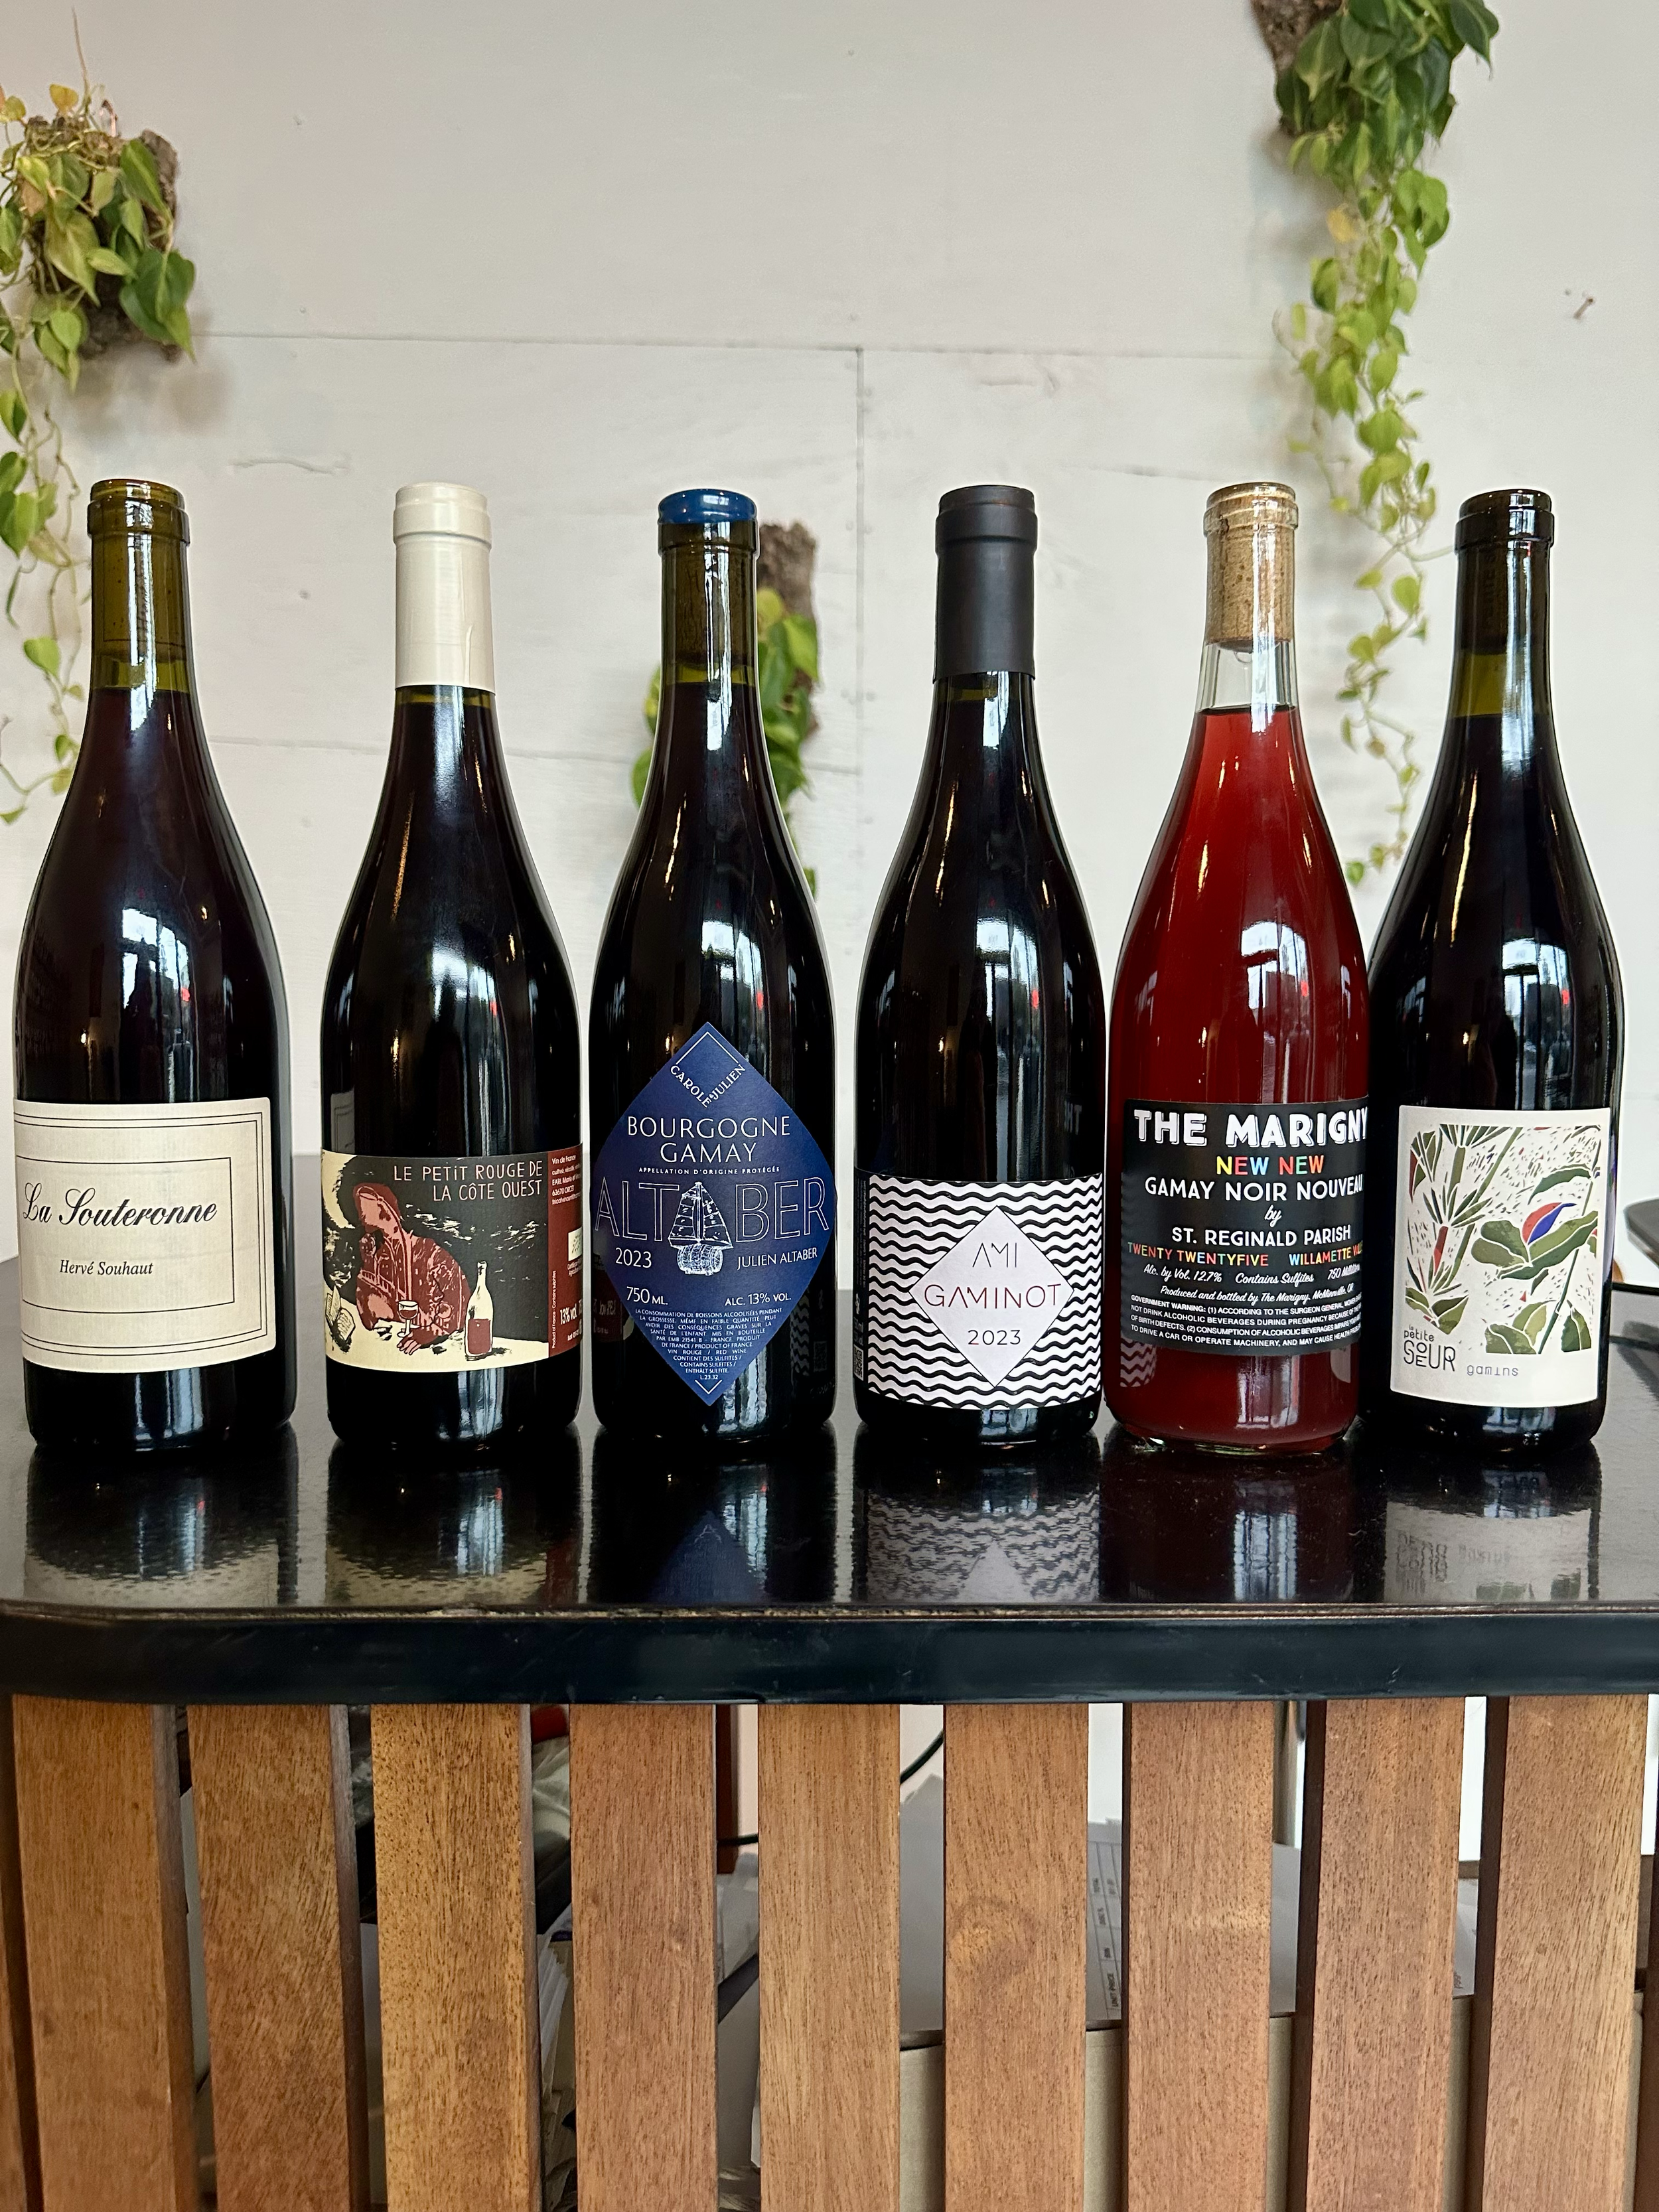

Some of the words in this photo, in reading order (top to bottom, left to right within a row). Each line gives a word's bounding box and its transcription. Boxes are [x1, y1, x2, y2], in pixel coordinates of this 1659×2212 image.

[670, 1065, 711, 1108] CAROLE
[711, 1064, 746, 1100] JULIEN
[628, 1116, 790, 1138] BOURGOGNE
[1133, 1109, 1207, 1147] THE
[1226, 1106, 1368, 1148] MARIGNY
[660, 1142, 757, 1163] GAMAY
[394, 1165, 411, 1181] LE
[476, 1162, 525, 1179] ROUGE
[529, 1160, 543, 1177] DE
[1216, 1156, 1269, 1175] NEW
[1279, 1155, 1324, 1175] NEW
[433, 1185, 451, 1201] LA
[459, 1183, 494, 1201] CÔTE
[502, 1179, 542, 1199] OUEST
[552, 1187, 564, 1196] 63670
[1145, 1177, 1214, 1200] GAMAY
[1226, 1181, 1287, 1201] NOIR
[1297, 1173, 1363, 1201] NOUVEAU
[23, 1182, 52, 1222] La
[59, 1187, 218, 1227] Souteronne
[1264, 1205, 1282, 1228] by
[1172, 1227, 1197, 1244] ST.
[1205, 1230, 1297, 1247] REGINALD
[1303, 1224, 1351, 1245] PARISH
[615, 1248, 652, 1268] 2023
[737, 1254, 777, 1270] JULIEN
[780, 1247, 818, 1264] ALTABER
[972, 1242, 1017, 1268] AMI
[1127, 1242, 1173, 1260] TWENTY
[1177, 1250, 1269, 1266] TWENTYFIVE
[1289, 1247, 1352, 1266] WILLAMETTE
[60, 1260, 94, 1275] Hervé
[98, 1262, 153, 1276] Souhaut
[1143, 1264, 1158, 1276] Alc.
[1161, 1266, 1172, 1282] by
[1174, 1268, 1190, 1280] Vol.
[1193, 1270, 1222, 1282] 12.7%
[1327, 1268, 1341, 1280] 750
[1235, 1272, 1279, 1284] Contains
[1280, 1272, 1314, 1288] Sulfites
[626, 1286, 650, 1304] 750
[725, 1296, 746, 1306] ALC.
[748, 1293, 770, 1305] 13%
[773, 1291, 792, 1303] VOL.
[924, 1283, 1062, 1309] GAMINOT
[1131, 1294, 1170, 1307] GOVERNMENT
[1171, 1302, 1206, 1313] WARNING:
[1208, 1306, 1216, 1315] (1)
[1290, 1306, 1321, 1315] SURGEON
[1161, 1286, 1198, 1299] Produced
[1198, 1291, 1217, 1300] and
[1216, 1291, 1248, 1301] bottled
[1248, 1292, 1258, 1306] by
[1261, 1292, 1275, 1301] The
[560, 1307, 571, 1325] 13%
[641, 1309, 685, 1317] CONSOMMATION
[1143, 1307, 1163, 1317] DRINK
[1163, 1311, 1205, 1323] ALCOHOLIC
[1207, 1316, 1255, 1325] BEVERAGES
[1288, 1315, 1327, 1325] PREGNANCY
[1328, 1310, 1348, 1321] BECAUSE
[1138, 1316, 1155, 1325] BIRTH
[1155, 1320, 1186, 1331] DEFECTS.
[1187, 1325, 1195, 1333] (2)
[1196, 1326, 1250, 1336] CONSUMPTION
[1301, 1324, 1334, 1335] BEVERAGES
[1334, 1319, 1349, 1330] IMPAIRS
[1404, 1329, 1434, 1342] petite
[968, 1329, 1021, 1345] 2023
[1139, 1327, 1158, 1337] DRIVE
[1194, 1336, 1232, 1345] OPERATE
[1234, 1339, 1280, 1347] MACHINERY,
[1314, 1334, 1333, 1344] CAUSE
[1334, 1329, 1350, 1340] HEALTH
[1467, 1364, 1518, 1376] gamins
